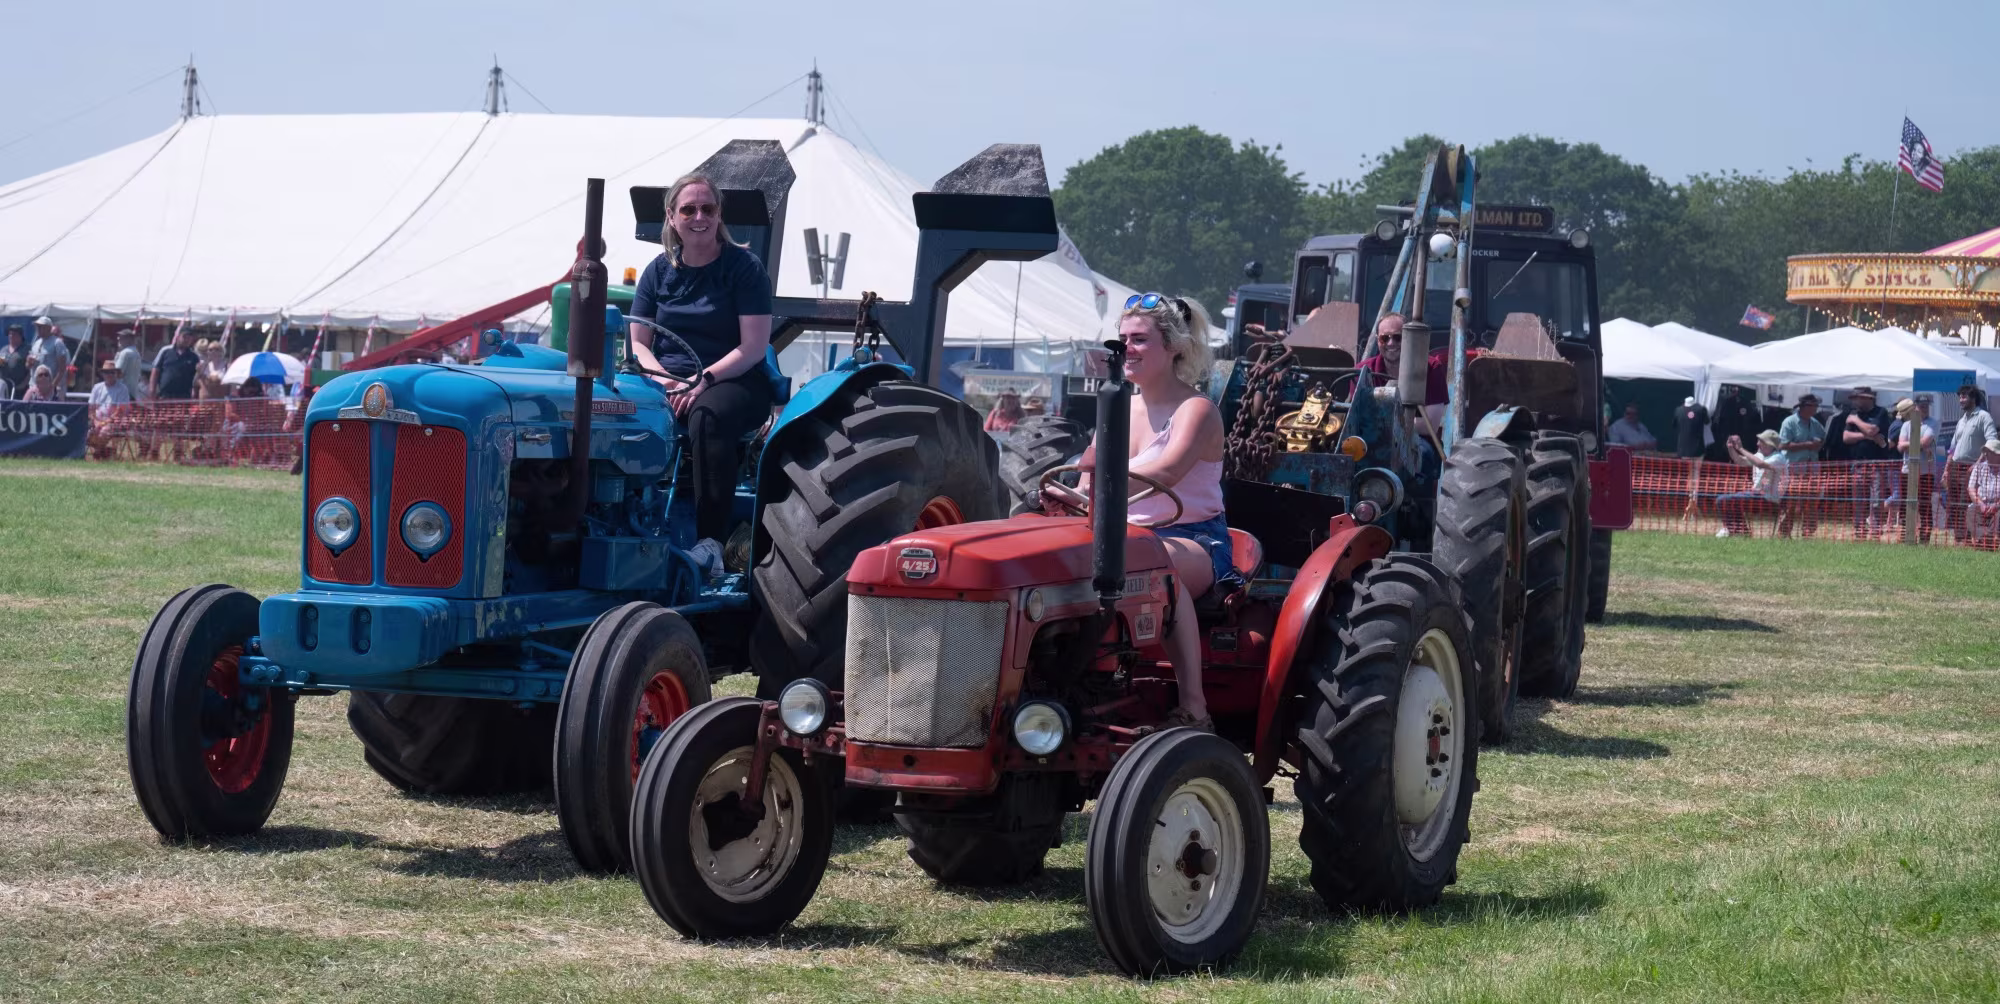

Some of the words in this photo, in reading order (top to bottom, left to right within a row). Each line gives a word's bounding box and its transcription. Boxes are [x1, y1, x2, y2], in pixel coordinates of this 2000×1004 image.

[1517, 211, 1544, 227] LTD.
[601, 402, 617, 412] SUPER
[902, 560, 930, 571] 4/25
